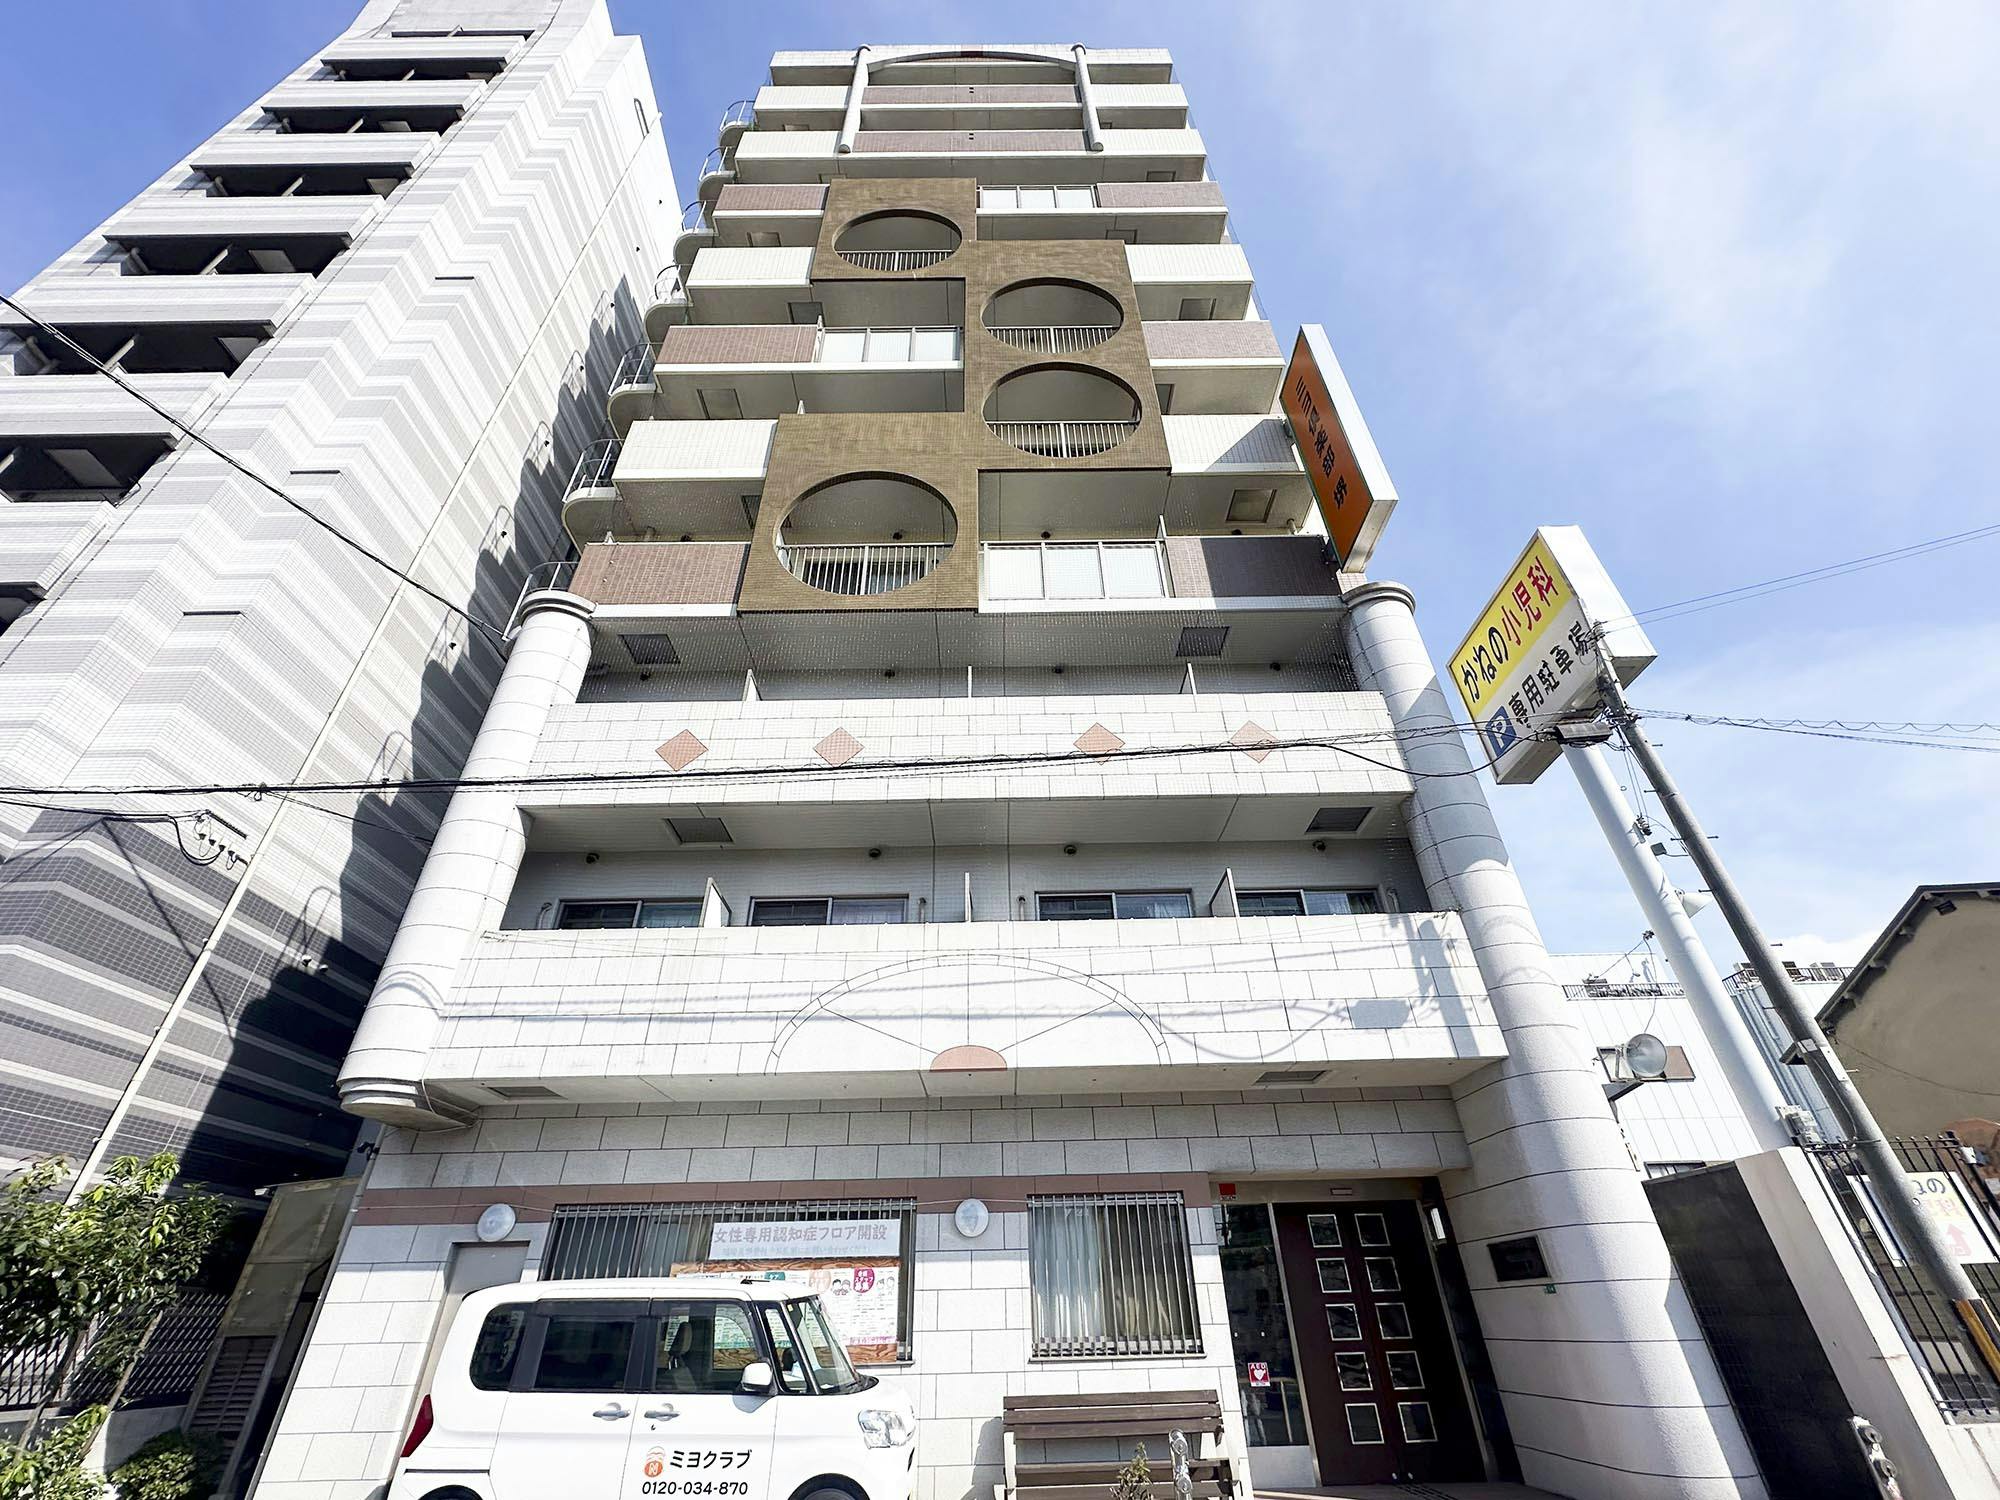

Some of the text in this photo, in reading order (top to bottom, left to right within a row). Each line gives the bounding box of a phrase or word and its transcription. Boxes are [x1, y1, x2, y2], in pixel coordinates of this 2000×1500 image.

[1460, 555, 1559, 703] かねの小児科
[1508, 620, 1590, 729] 専用駐車場
[713, 1223, 888, 1244] 女性専用認知症フロア開設
[669, 1449, 753, 1469] ミヨクラブ
[641, 1481, 749, 1496] 0120-034-870
